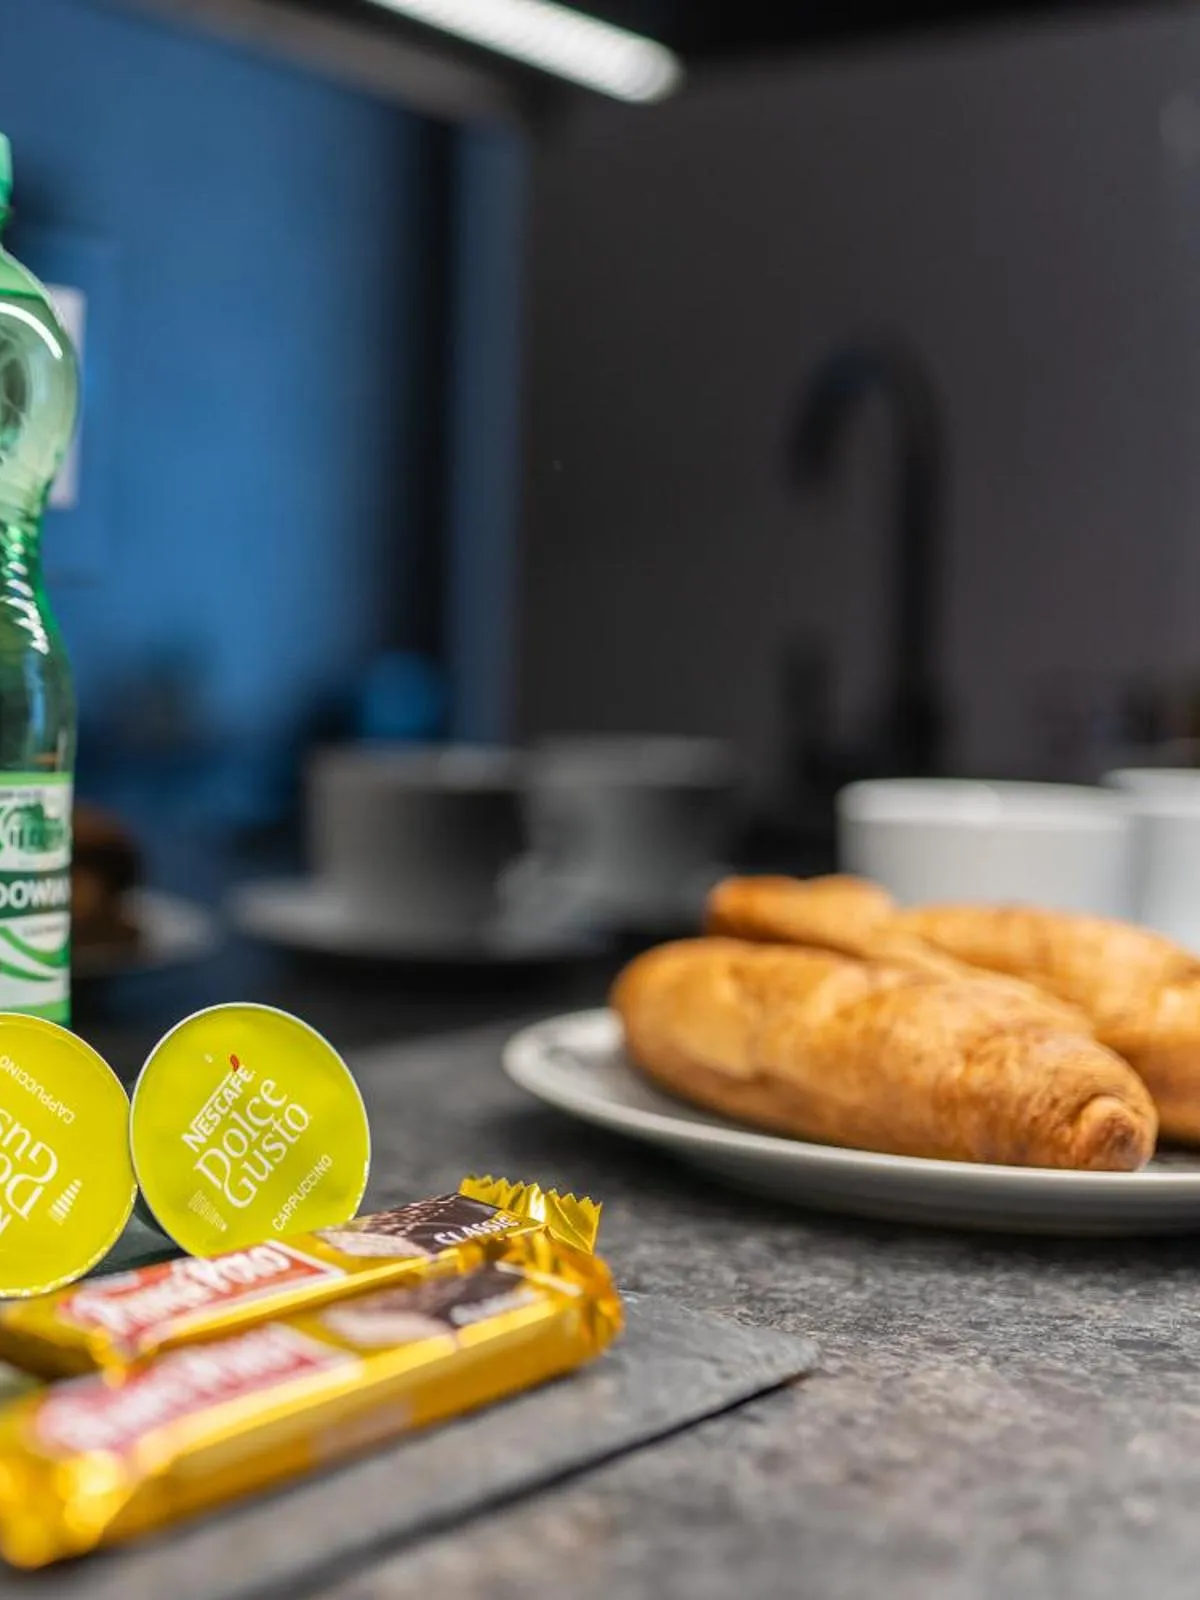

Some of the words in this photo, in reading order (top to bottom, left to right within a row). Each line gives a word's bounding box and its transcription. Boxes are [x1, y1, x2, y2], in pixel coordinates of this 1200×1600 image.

[192, 1078, 288, 1191] Dolce
[223, 1102, 311, 1209] Gusto
[270, 1154, 334, 1232] CAPPUCCINO
